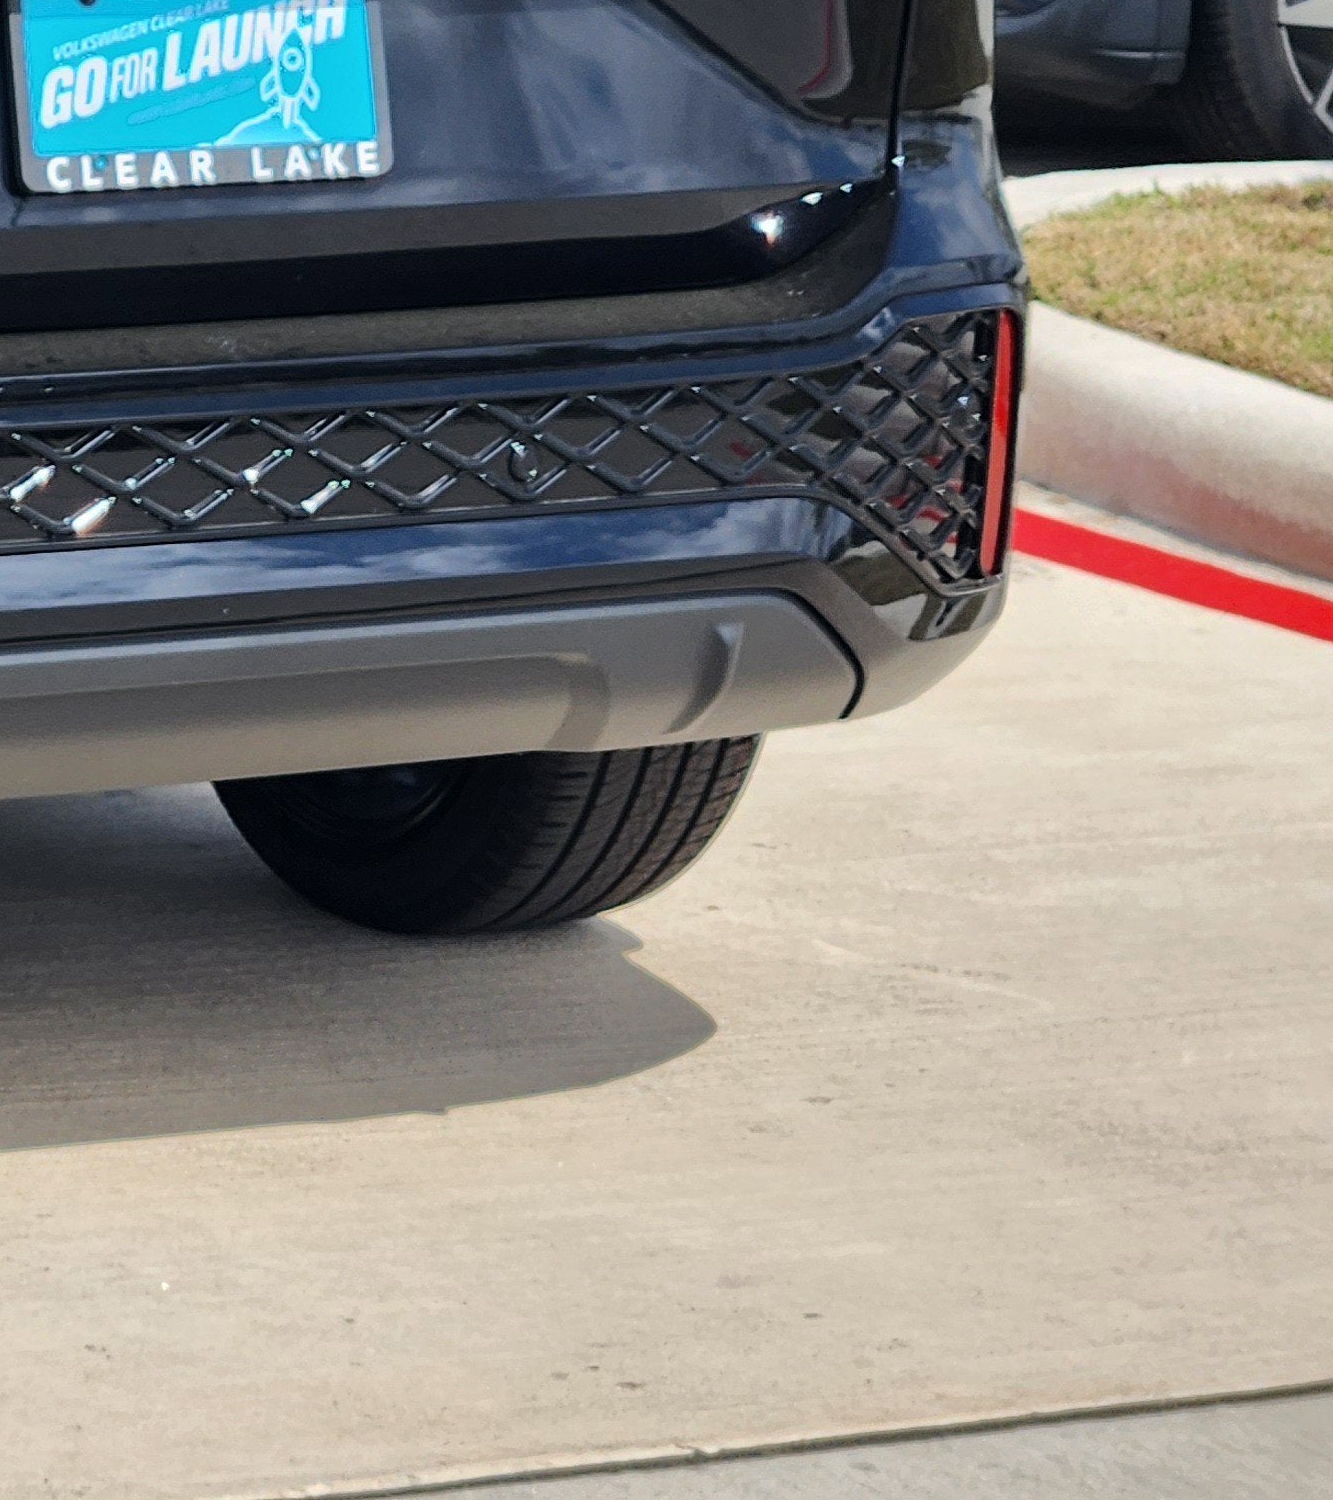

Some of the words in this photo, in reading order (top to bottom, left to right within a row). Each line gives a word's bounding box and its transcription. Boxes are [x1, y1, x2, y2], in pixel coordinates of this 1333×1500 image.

[53, 18, 148, 60] VOLKSWAGEN
[40, 56, 107, 129] GO
[109, 47, 158, 103] FOR
[46, 150, 216, 192] CLEAR
[252, 141, 381, 182] LAKE
